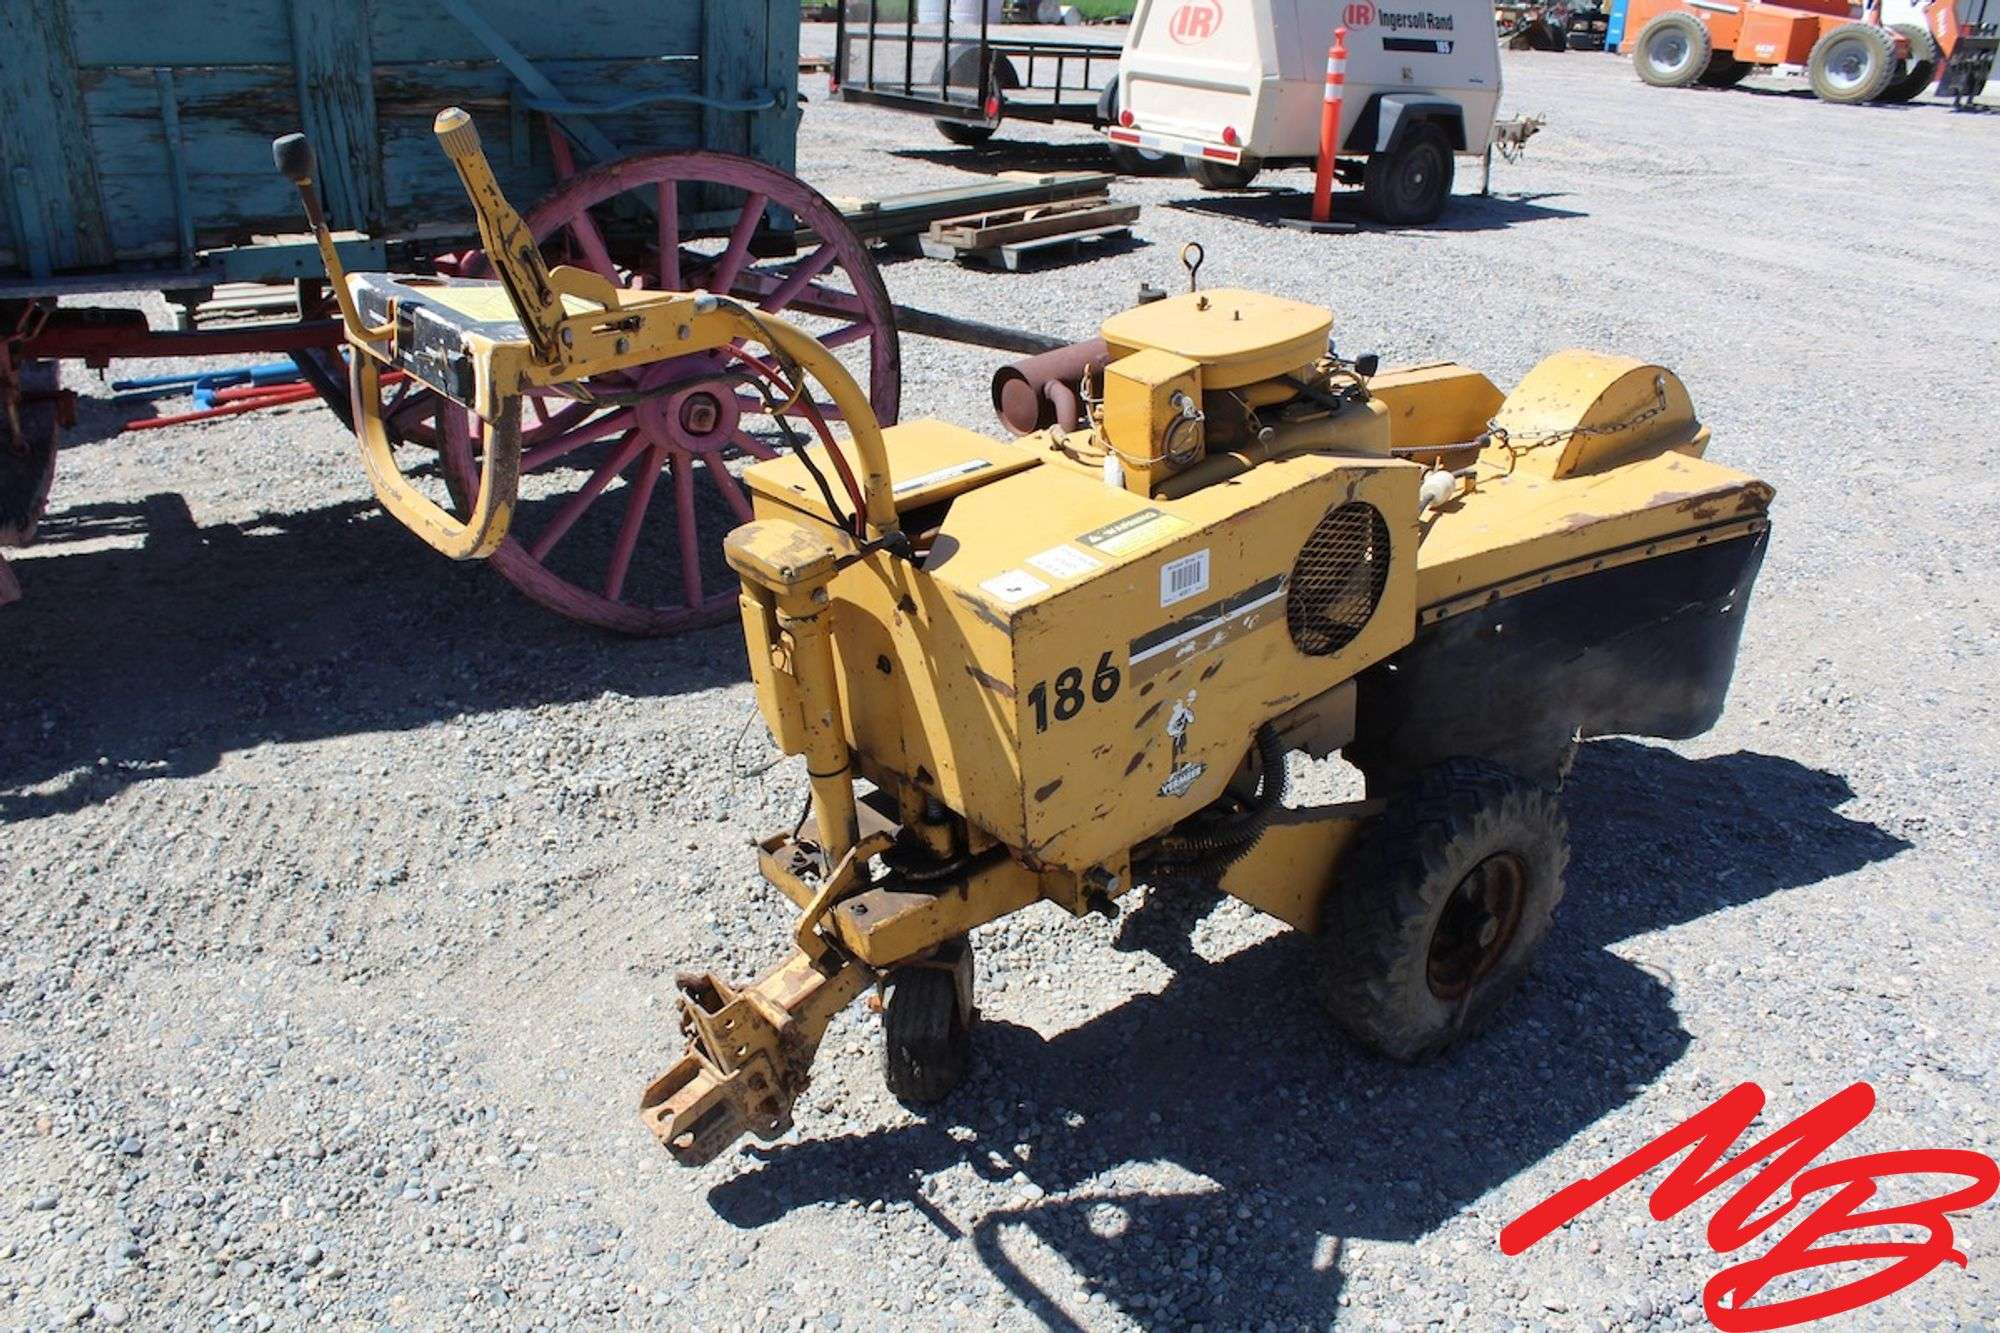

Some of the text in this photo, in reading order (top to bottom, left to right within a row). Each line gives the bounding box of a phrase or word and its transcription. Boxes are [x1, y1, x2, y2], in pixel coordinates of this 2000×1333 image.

[1178, 5, 1213, 38] IR
[1347, 3, 1371, 26] IR
[1028, 650, 1121, 735] 186
